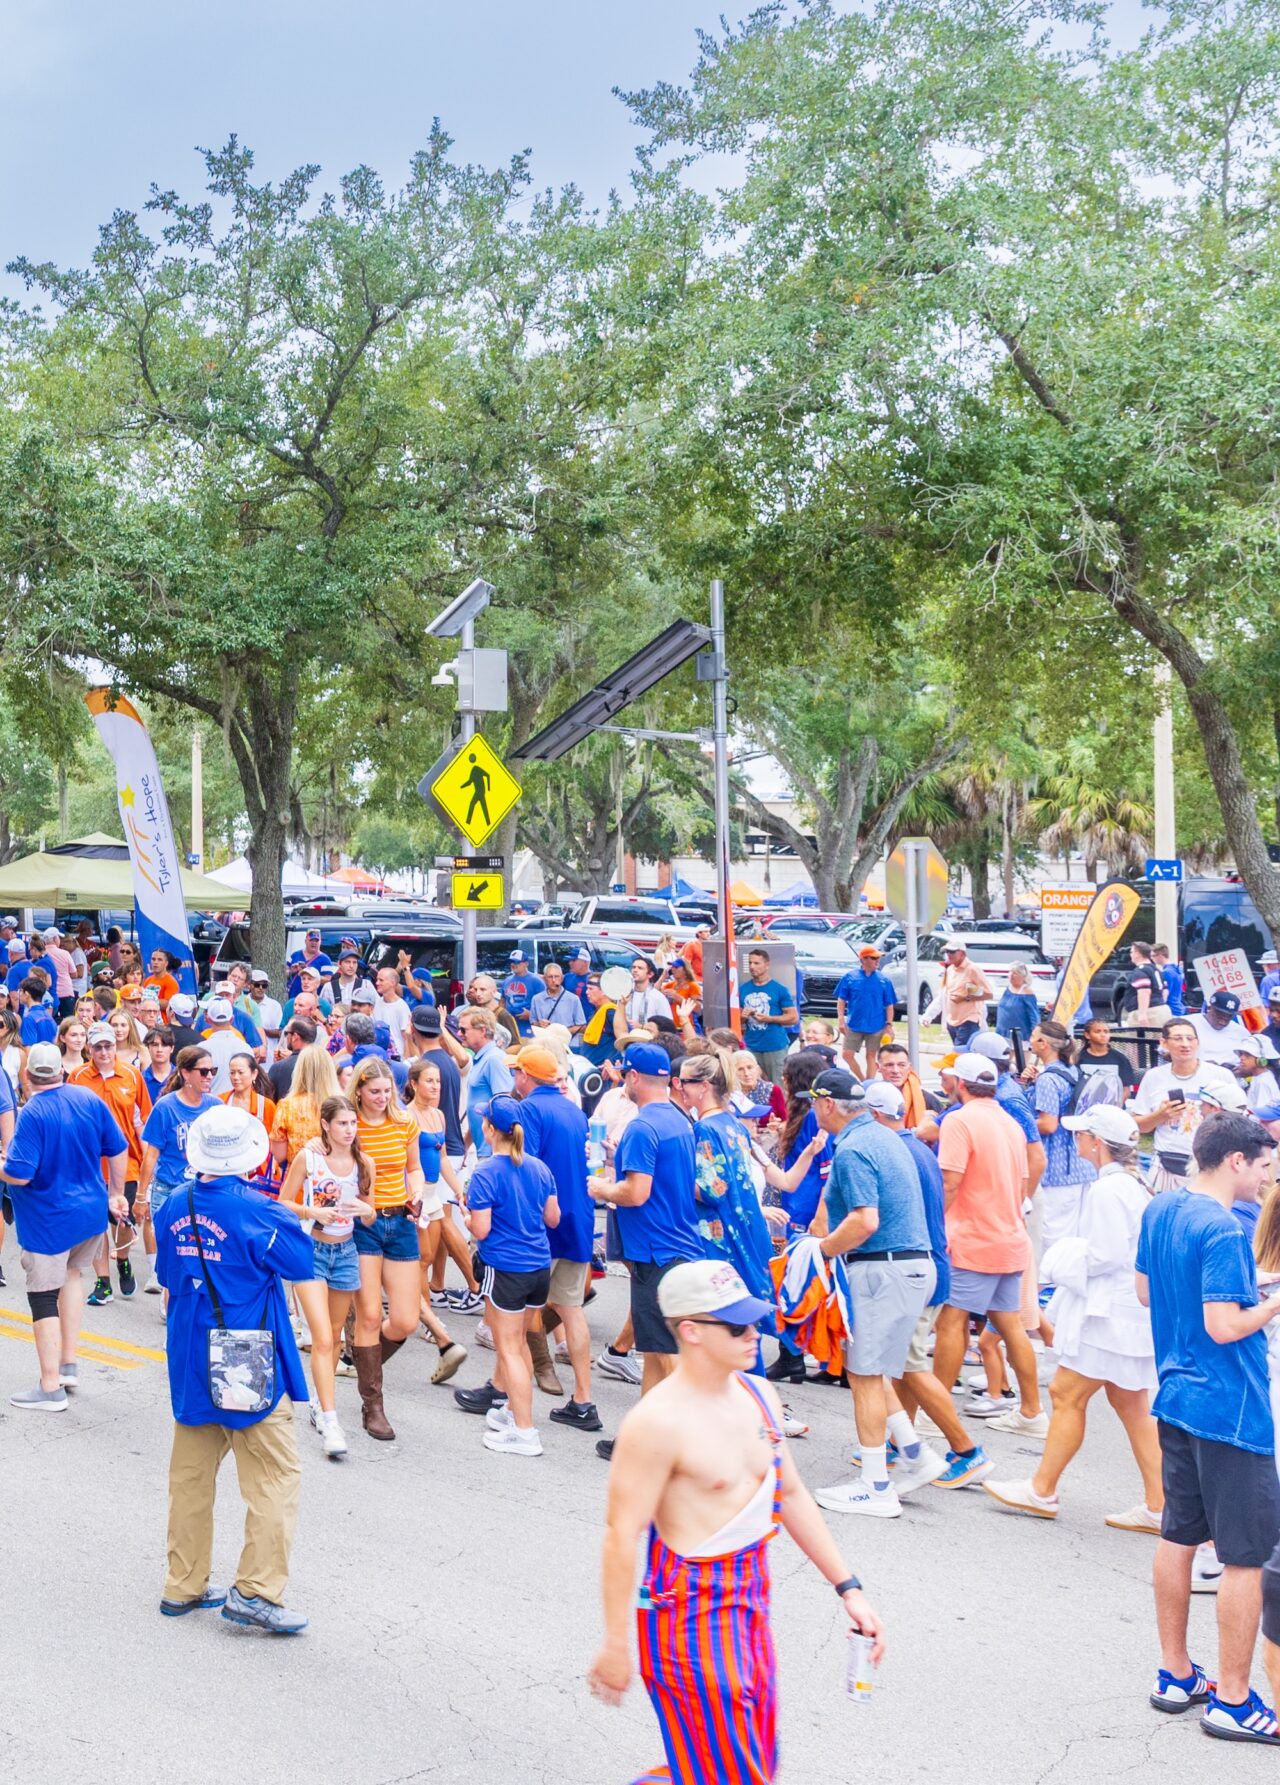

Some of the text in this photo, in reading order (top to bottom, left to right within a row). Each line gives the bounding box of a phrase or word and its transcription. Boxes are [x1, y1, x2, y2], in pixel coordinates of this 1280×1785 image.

[141, 774, 158, 826] Hope
[152, 832, 171, 894] Tyler's
[1150, 864, 1179, 877] A-1
[1043, 893, 1094, 906] ORANGE
[1203, 953, 1238, 970] 1046
[1209, 970, 1244, 986] 1068
[170, 1213, 228, 1241] PERFRMANCE
[849, 1493, 870, 1503] HOKA
